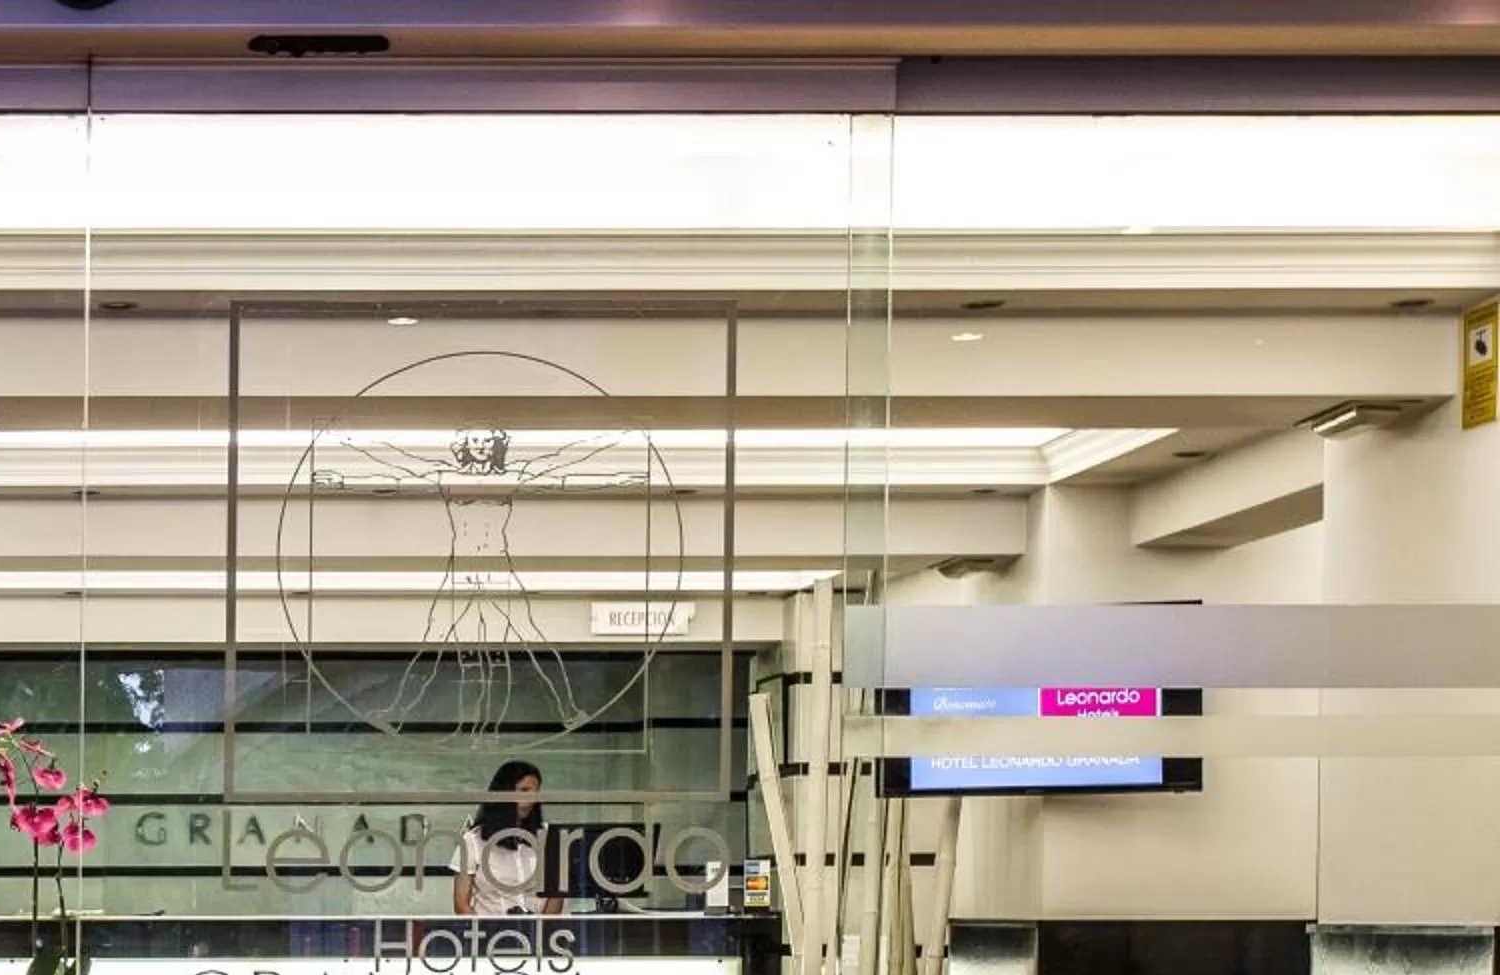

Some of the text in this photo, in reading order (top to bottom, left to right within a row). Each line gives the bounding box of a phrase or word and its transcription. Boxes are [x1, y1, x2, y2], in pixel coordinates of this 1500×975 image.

[1056, 687, 1141, 705] Leonardo
[221, 806, 731, 894] Leonardo
[373, 917, 575, 973] Hotels
